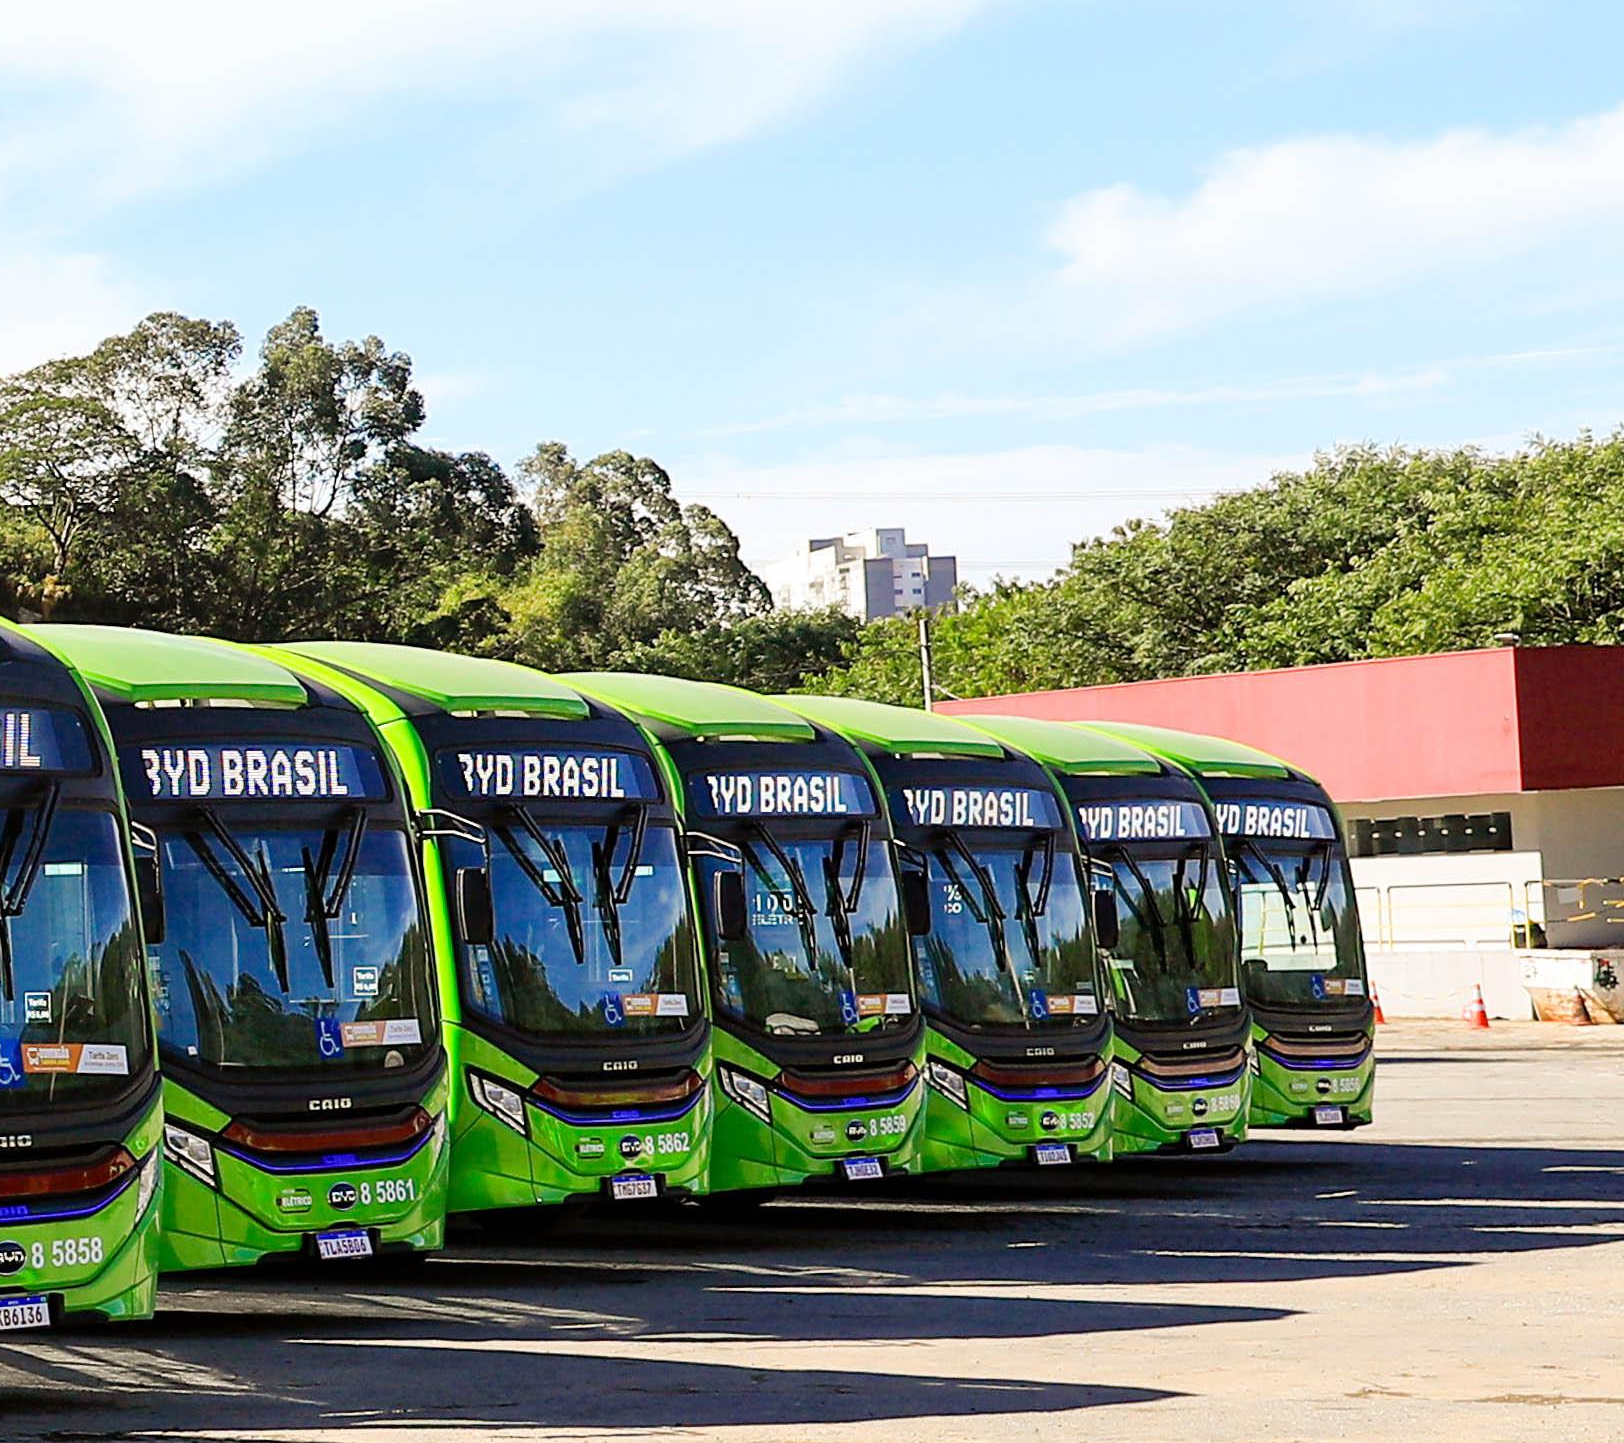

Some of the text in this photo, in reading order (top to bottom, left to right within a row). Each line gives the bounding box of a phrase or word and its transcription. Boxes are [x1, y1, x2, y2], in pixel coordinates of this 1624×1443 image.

[221, 750, 348, 796] BRASIL
[522, 755, 625, 798] BRASIL
[760, 776, 847, 813] BRASIL
[952, 789, 1034, 826] BRASIL
[1118, 805, 1185, 837] BRASIL
[1213, 803, 1310, 838] YD BRASIL
[603, 1060, 638, 1071] CAIO
[833, 1054, 864, 1064] CAIO
[1026, 1048, 1055, 1056] CAIO
[308, 1098, 352, 1110] CAIO
[869, 1114, 906, 1136] 8 5859
[644, 1131, 690, 1155] 8 5862
[360, 1178, 415, 1205] 8 5861
[31, 1237, 104, 1269] 8 5858
